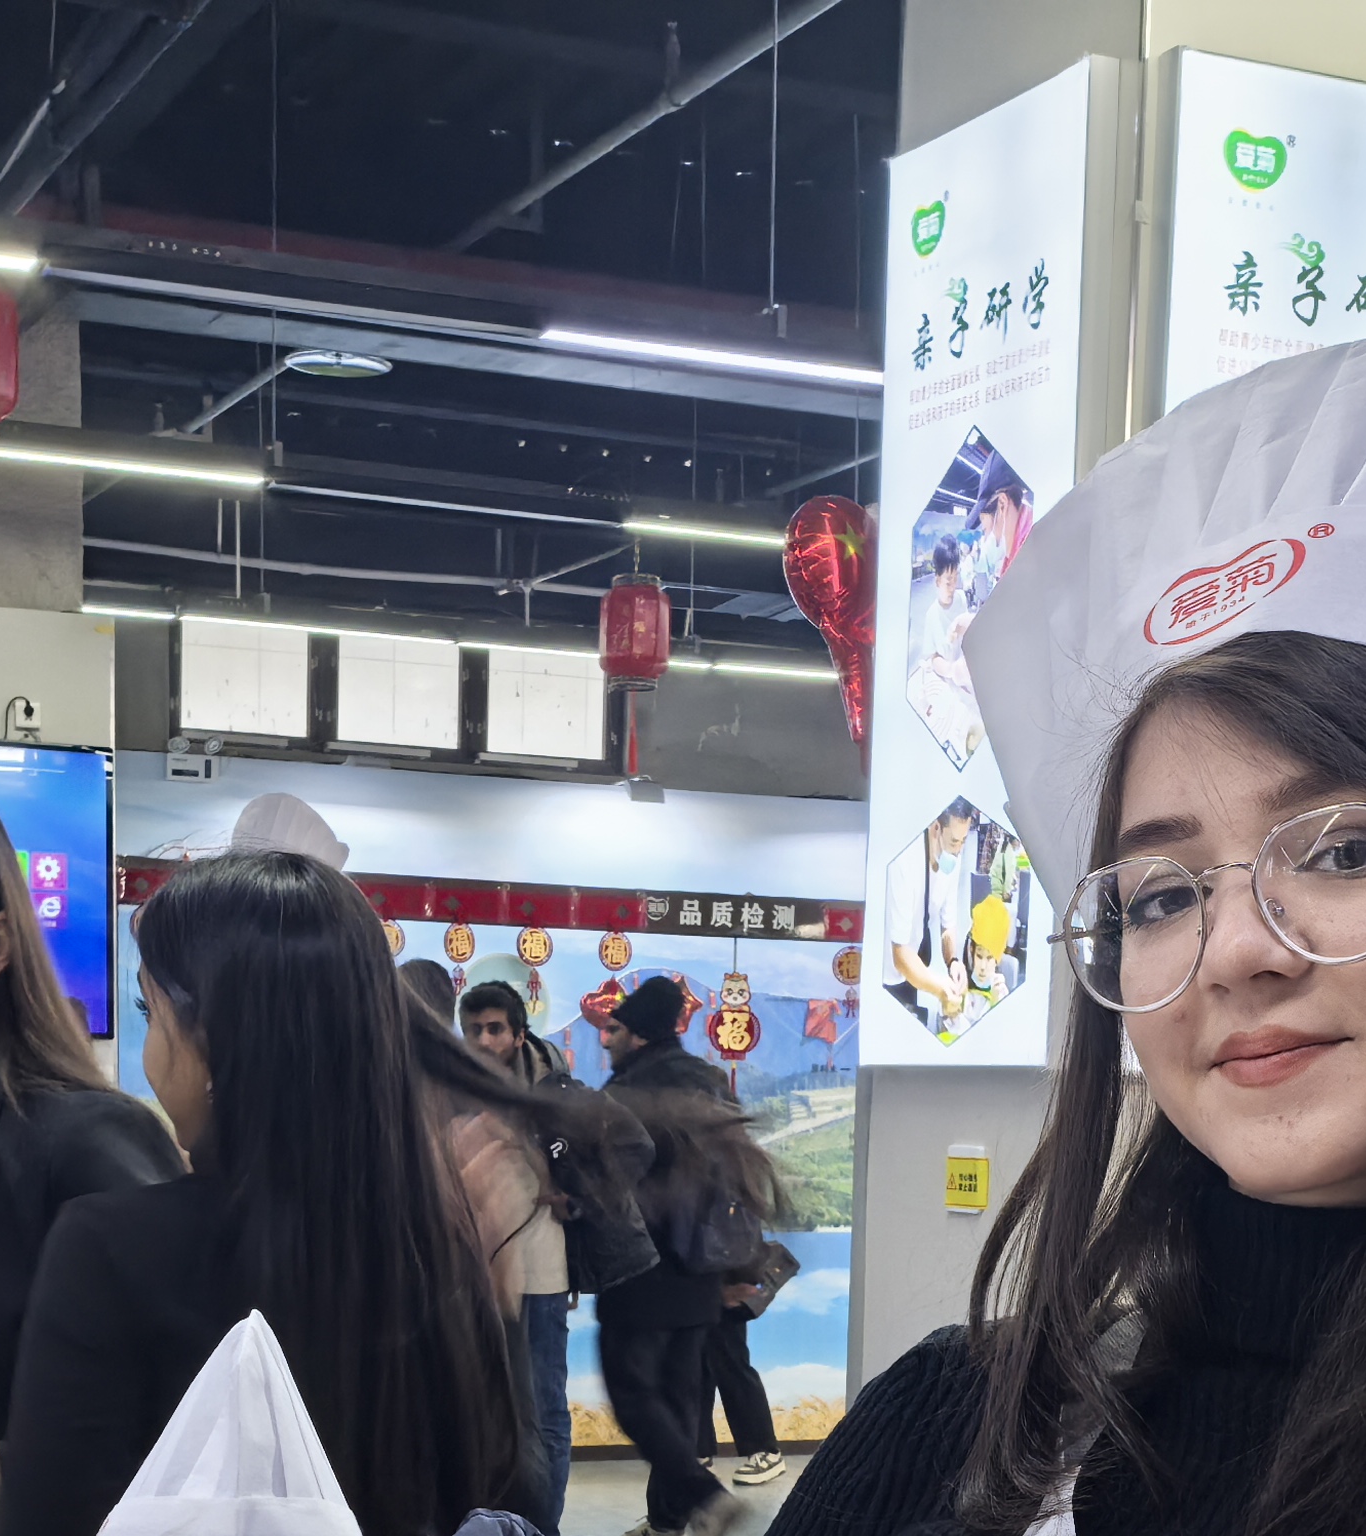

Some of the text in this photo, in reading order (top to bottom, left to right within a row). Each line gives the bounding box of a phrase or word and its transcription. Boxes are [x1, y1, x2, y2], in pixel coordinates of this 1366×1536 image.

[911, 258, 1049, 371] 亲子研学
[1168, 553, 1278, 630] 爱菊
[1185, 596, 1246, 630] 始于1934
[679, 899, 796, 930] 品质检测
[450, 927, 471, 960] 福
[522, 929, 549, 961] 福
[603, 935, 627, 966] 福
[716, 1012, 752, 1051] 福
